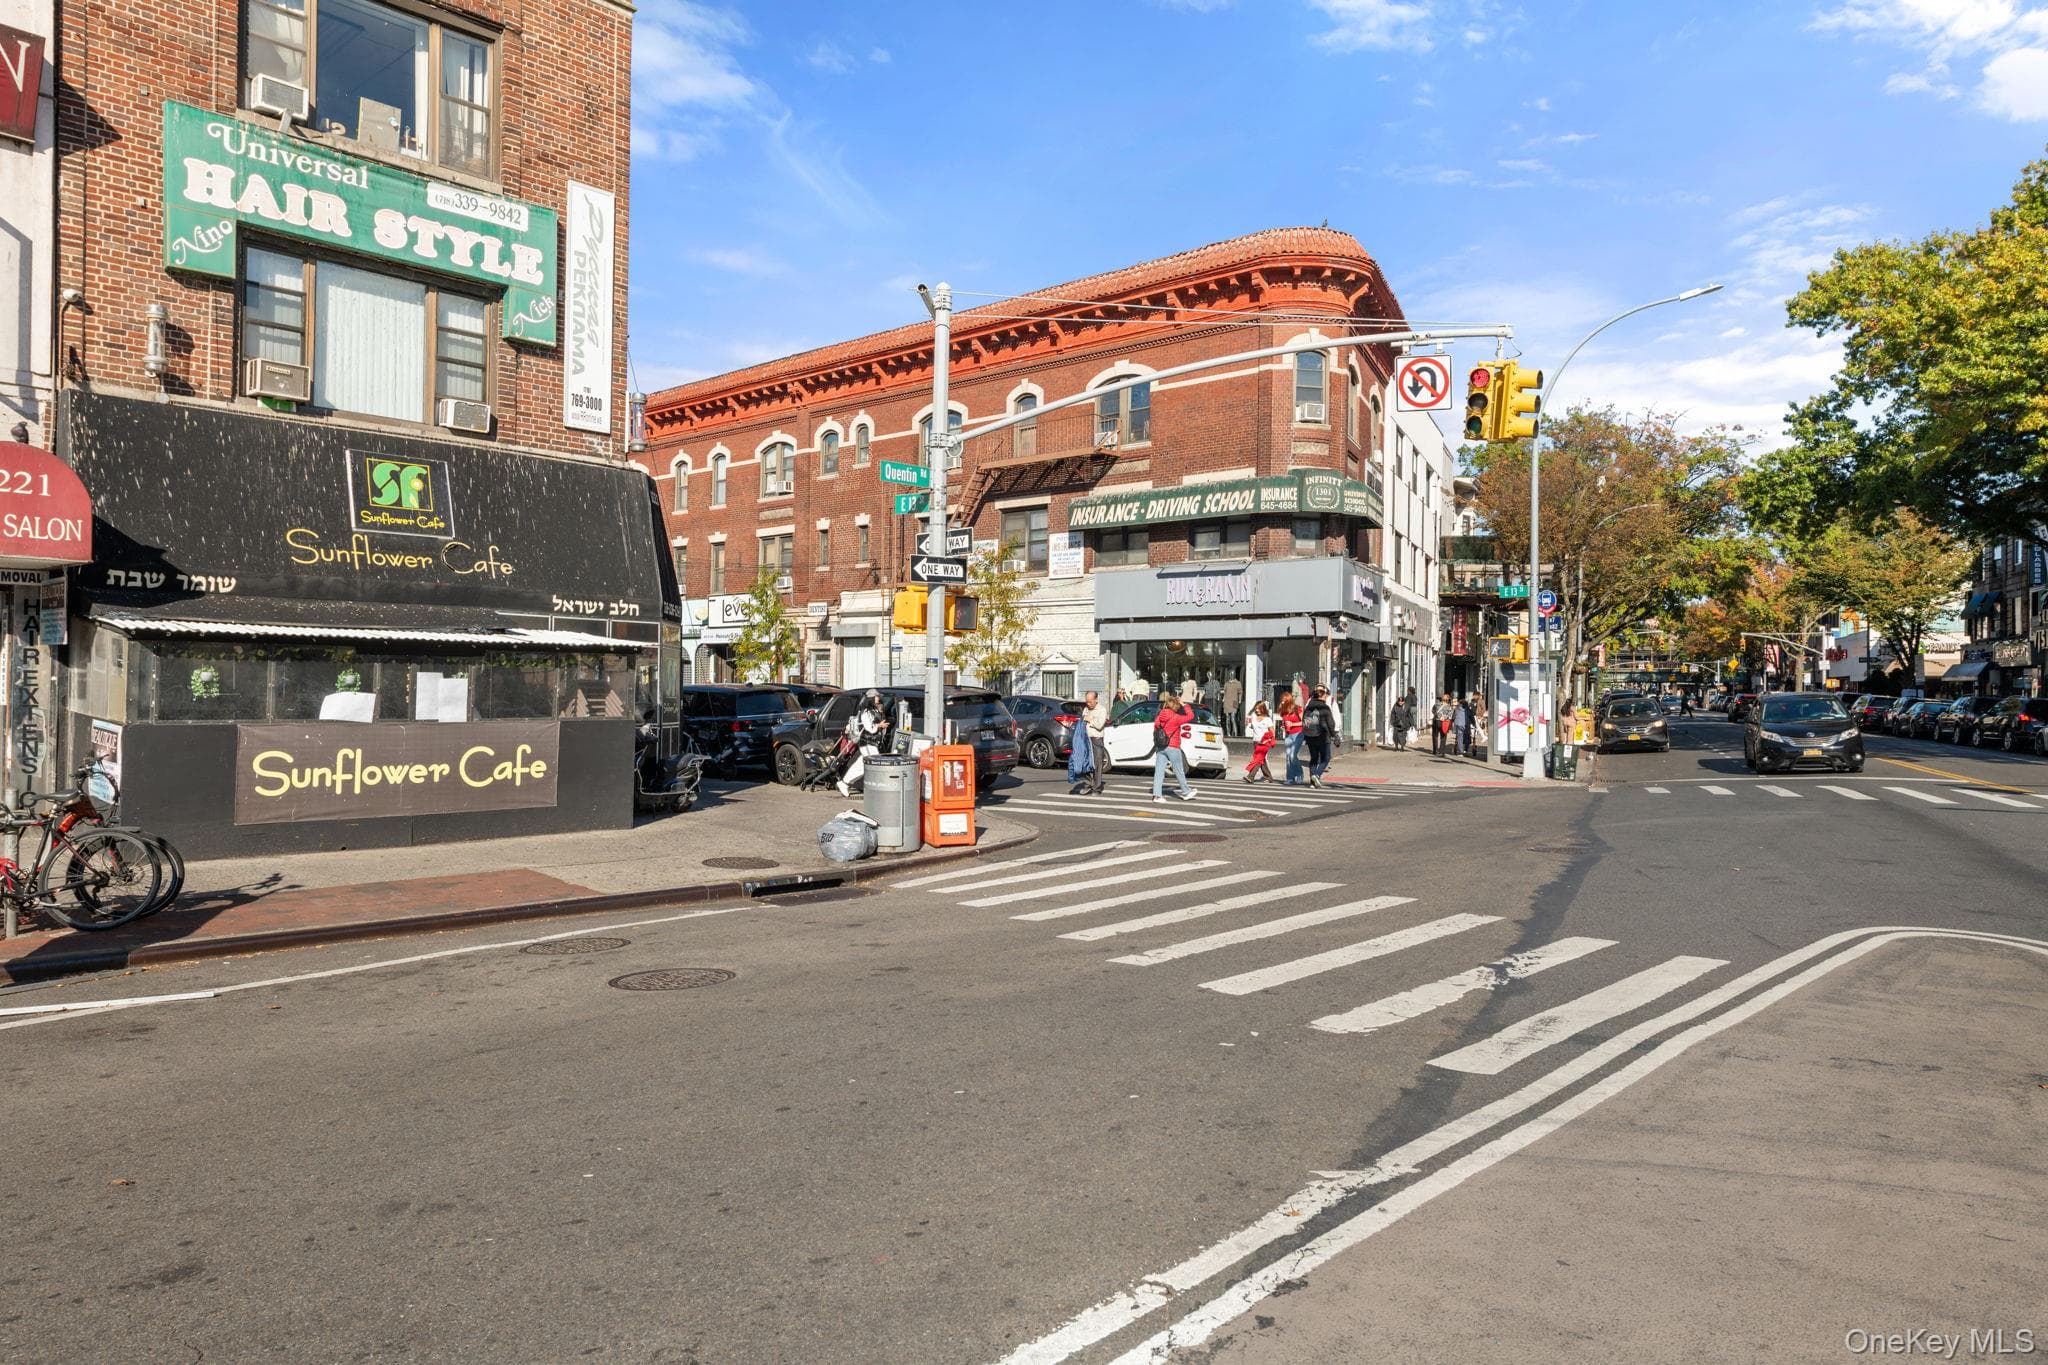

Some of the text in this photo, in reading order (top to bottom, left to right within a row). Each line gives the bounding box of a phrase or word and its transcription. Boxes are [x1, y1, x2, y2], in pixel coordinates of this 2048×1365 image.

[207, 122, 370, 189] Universal
[183, 157, 544, 286] HAIR STYLE
[172, 220, 233, 264] Nino
[512, 296, 555, 336] Nick
[571, 249, 587, 376] РЕКЛАМА
[571, 393, 603, 411] 769-3000
[885, 463, 927, 483] Quentin Rd
[1305, 475, 1343, 487] INFINITY
[1260, 487, 1298, 501] INSURANCE
[1314, 488, 1332, 496] 1301
[1343, 489, 1367, 498] DRIVING
[1344, 497, 1366, 506] SCHOOL
[900, 497, 906, 512] E
[908, 496, 917, 511] 13
[1070, 488, 1256, 526] INSURANCE DRIVING SCHOOL
[3, 513, 83, 542] SALON
[360, 510, 445, 530] Sunflower Cafe
[948, 536, 966, 547] WAY
[286, 528, 514, 579] Sunflower Cafe
[921, 563, 960, 576] ONE WAY
[106, 568, 237, 593] שומר שבת
[1504, 587, 1509, 597] E
[1510, 587, 1518, 596] 13
[552, 593, 604, 615] ישראל
[609, 599, 640, 617] חלב
[20, 669, 39, 810] EXTENSIO
[252, 743, 548, 797] Sunflower Cafe
